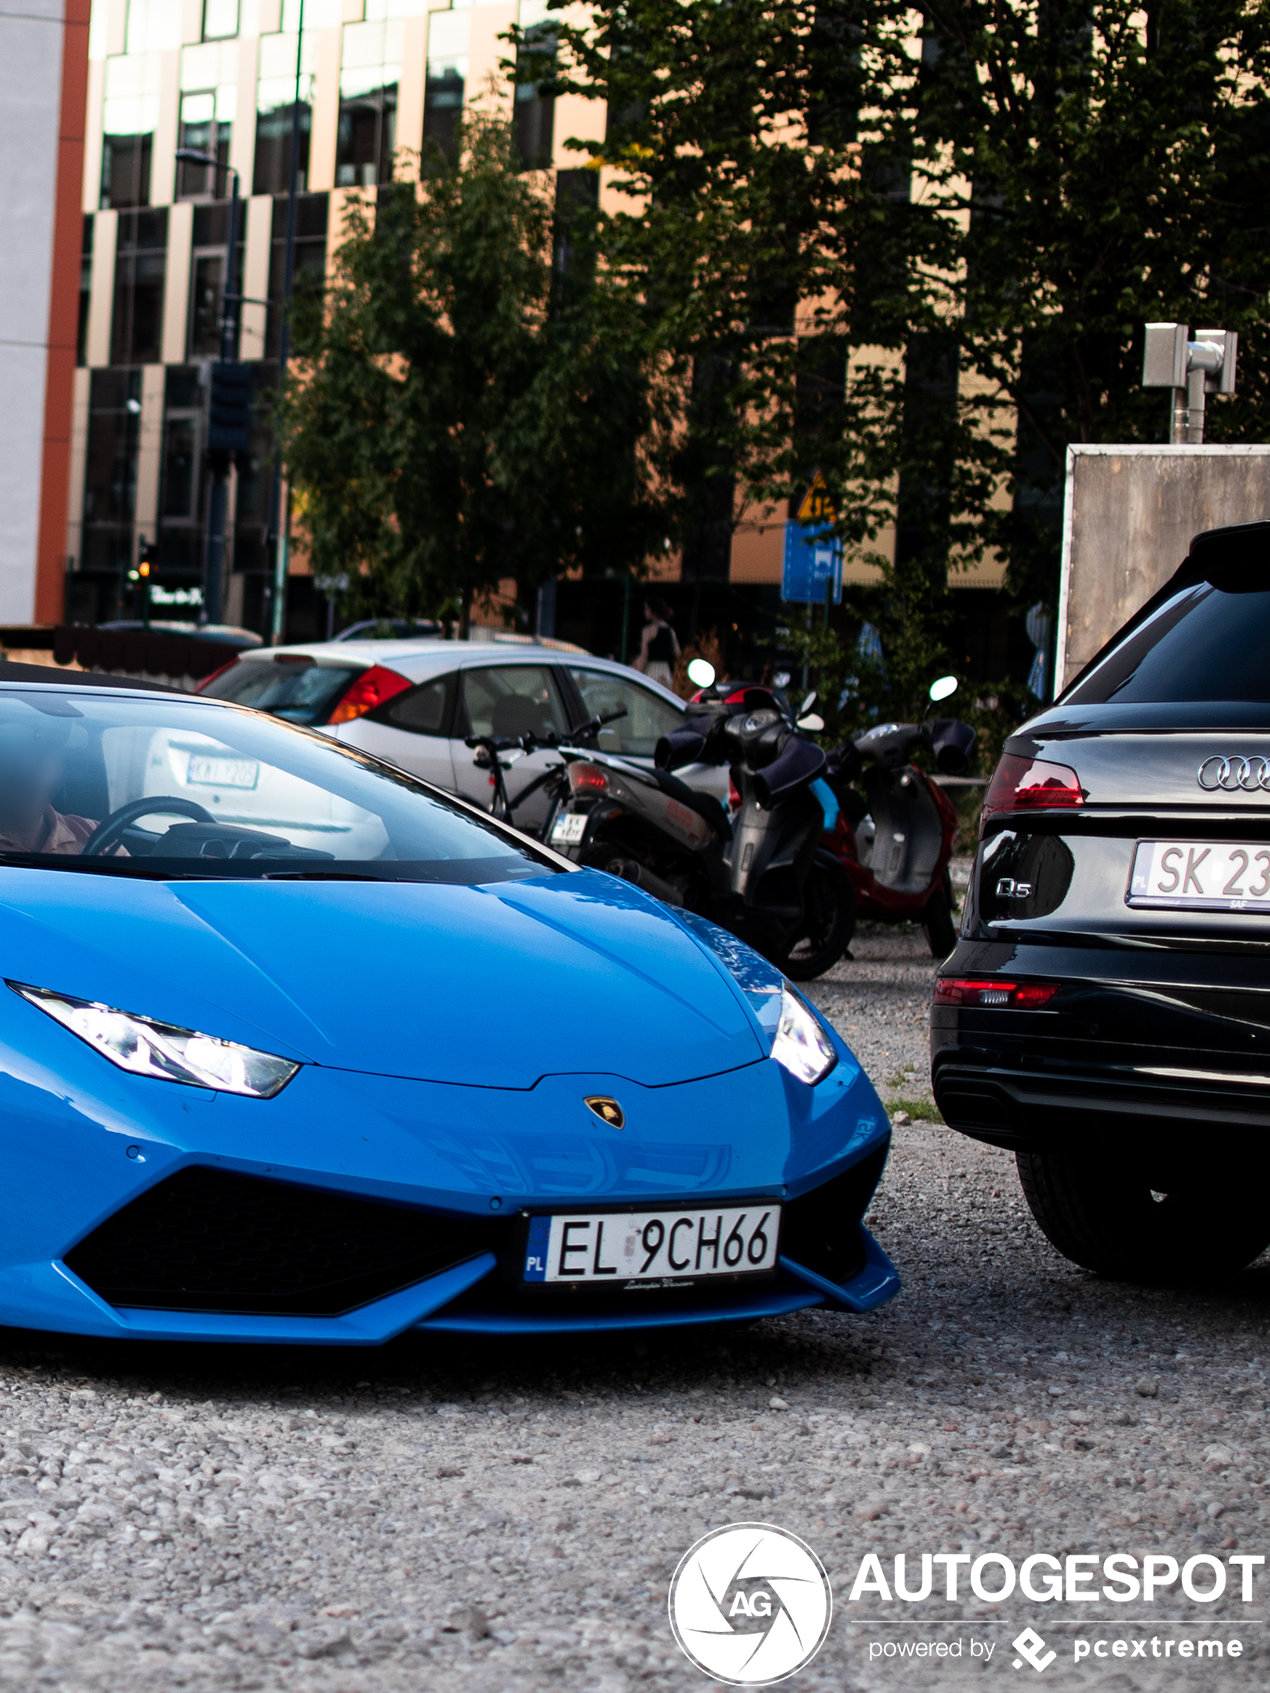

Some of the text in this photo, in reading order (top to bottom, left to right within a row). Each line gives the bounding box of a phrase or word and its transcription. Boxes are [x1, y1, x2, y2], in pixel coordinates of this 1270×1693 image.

[995, 877, 1032, 898] Q5
[1133, 847, 1270, 896] PL SK 23
[526, 1212, 772, 1276] PL EL 9CH66
